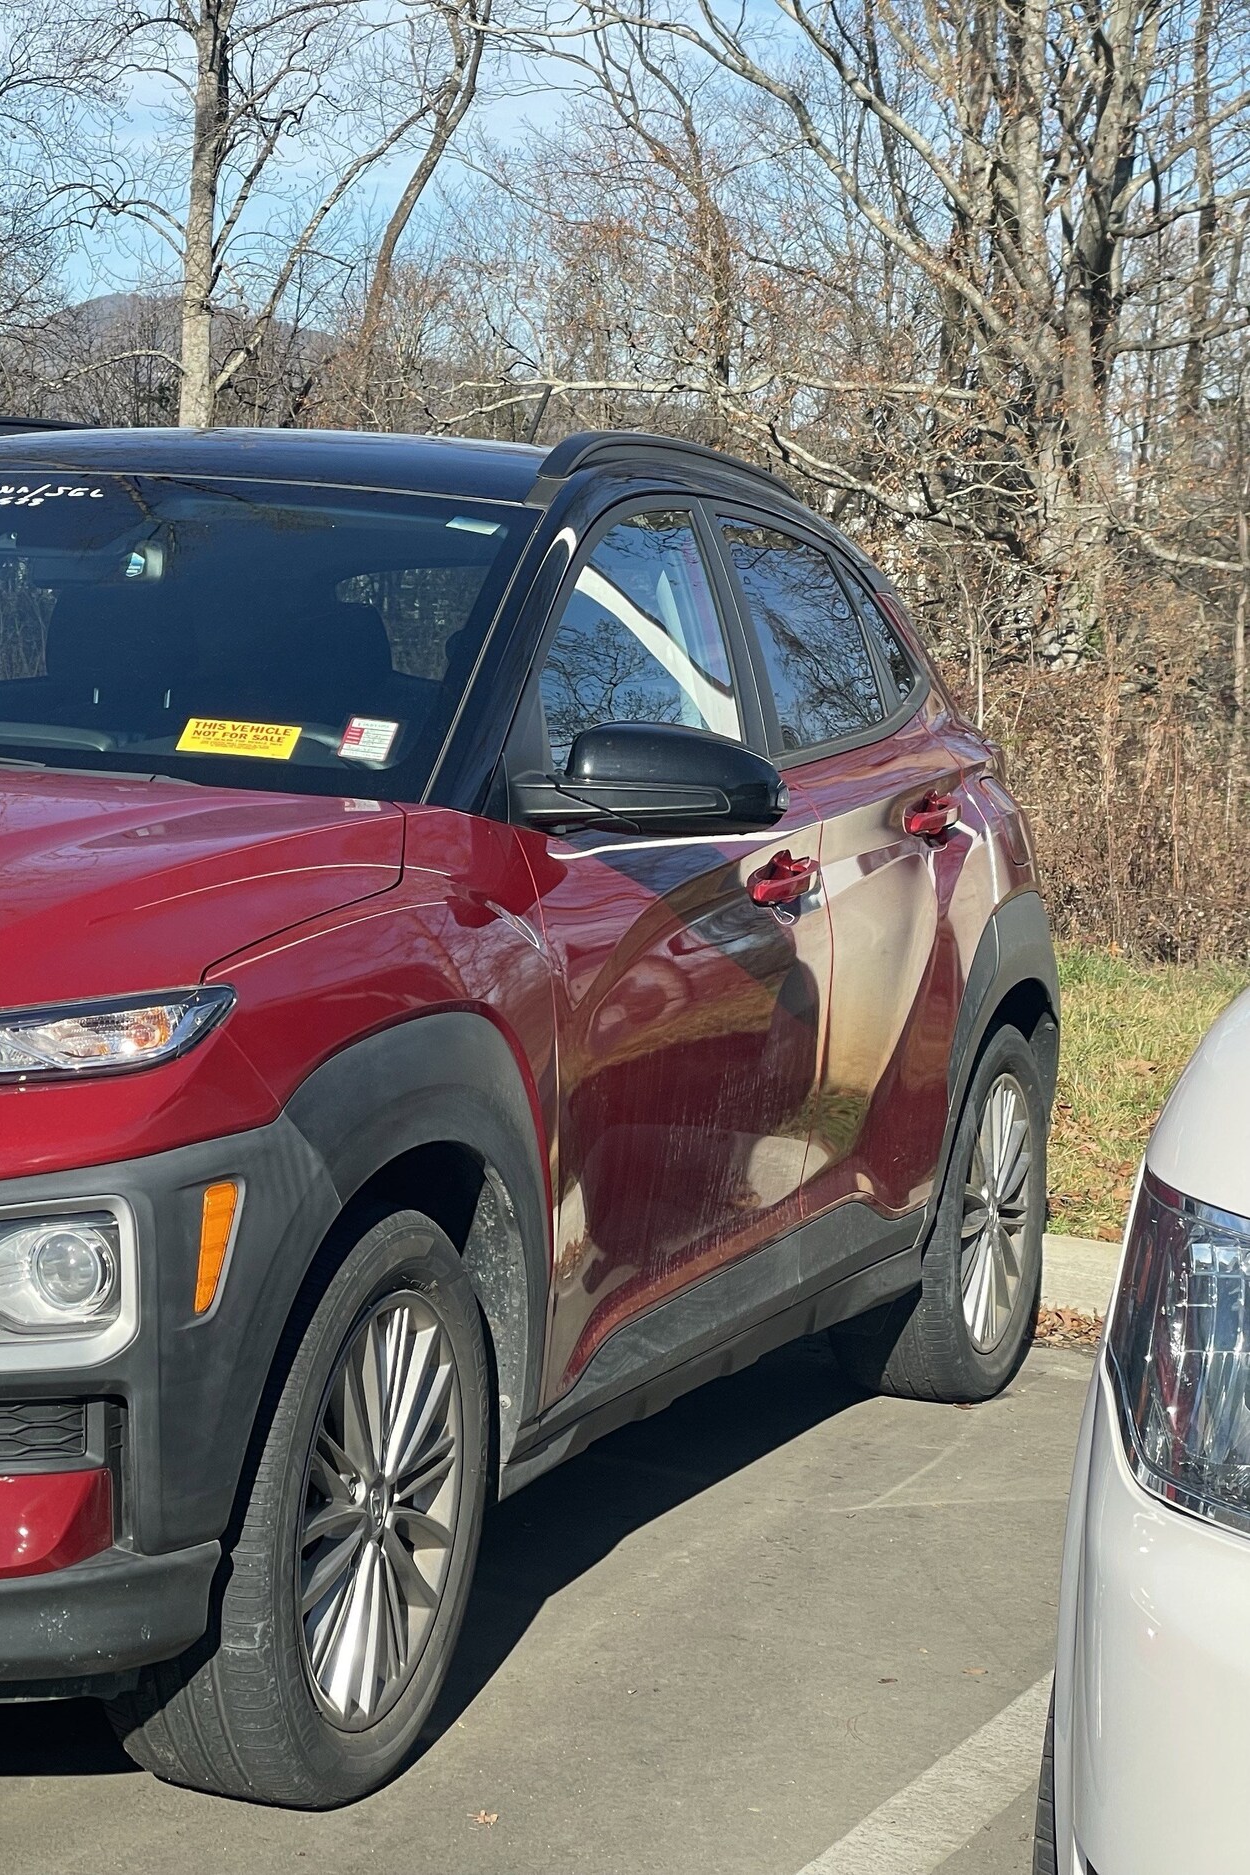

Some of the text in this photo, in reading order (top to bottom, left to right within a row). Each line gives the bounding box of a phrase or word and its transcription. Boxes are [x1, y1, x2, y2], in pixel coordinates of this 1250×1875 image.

[192, 729, 219, 738] NOT
[221, 731, 249, 740] FOR
[252, 734, 286, 743] SALE
[194, 721, 293, 737] THIS VEHICLE
